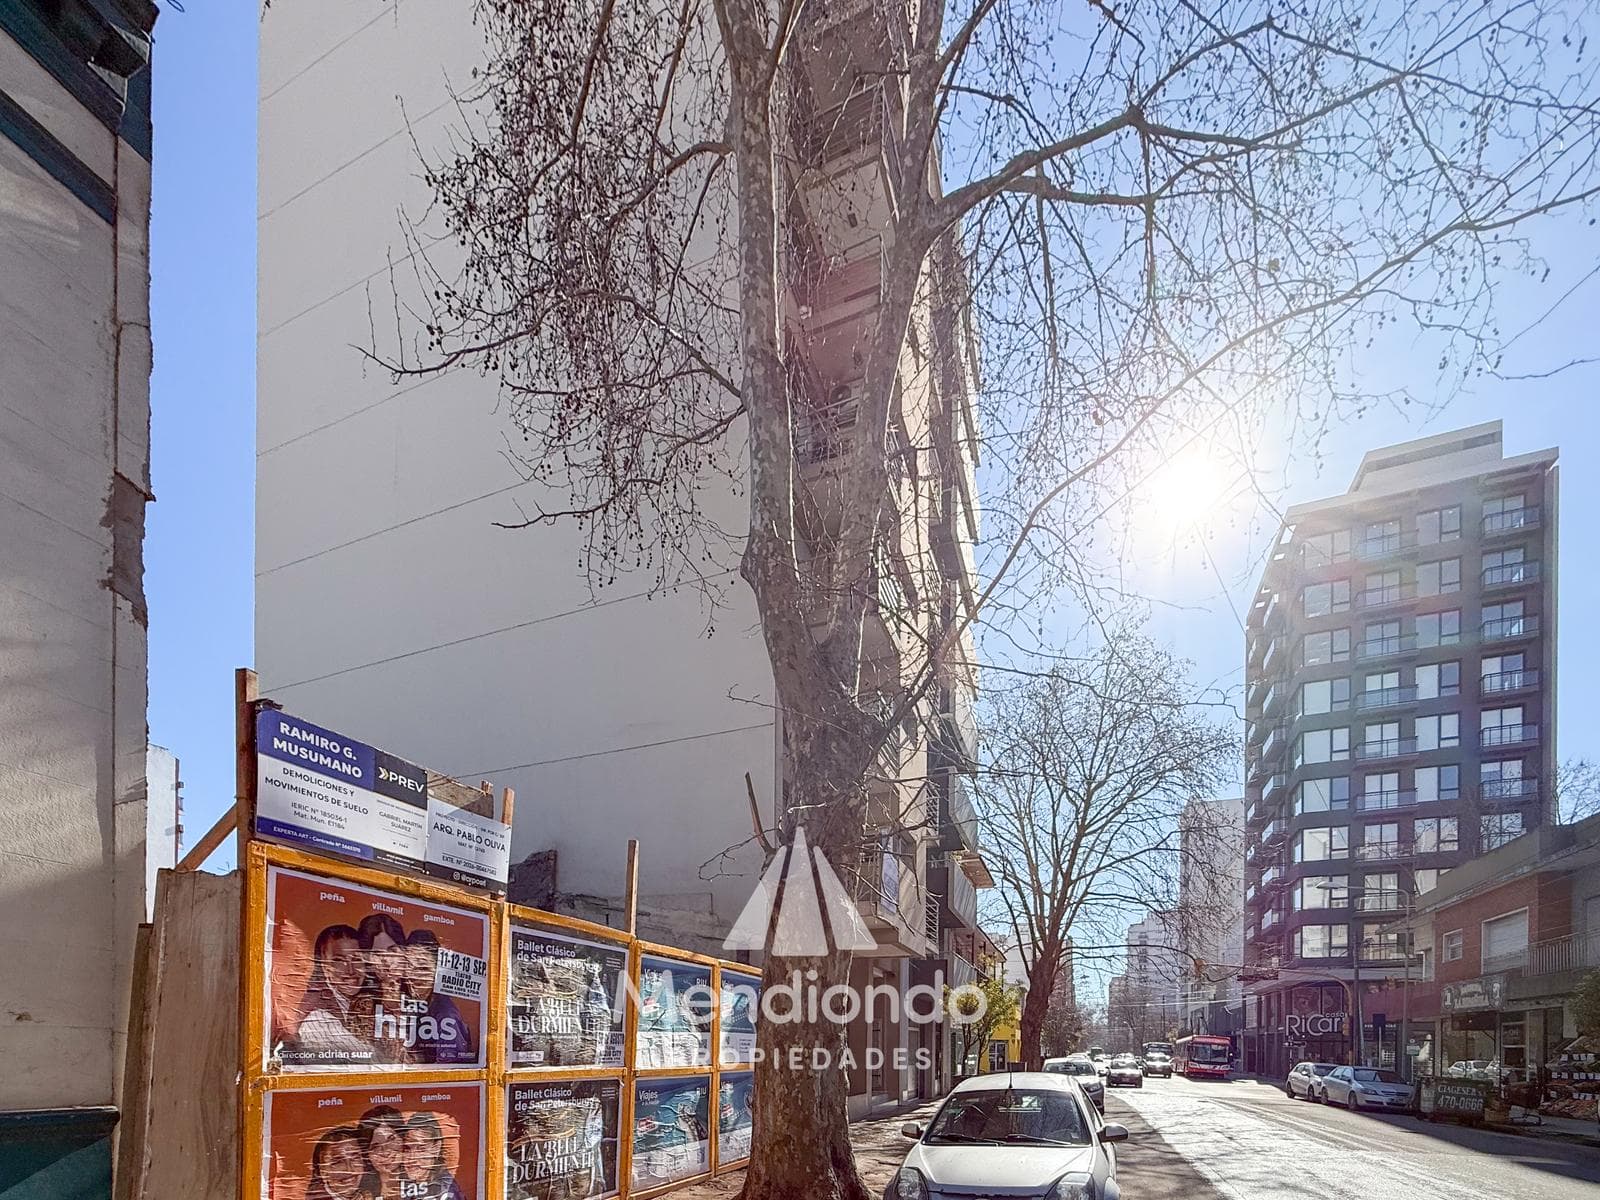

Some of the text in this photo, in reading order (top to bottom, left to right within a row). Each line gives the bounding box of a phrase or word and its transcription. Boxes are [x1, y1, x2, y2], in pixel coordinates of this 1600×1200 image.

[280, 721, 357, 760] RAMIRO G.
[273, 737, 362, 778] MUSUMANO
[283, 767, 348, 796] DEMOLICIONES
[389, 771, 424, 793] PREV
[265, 776, 329, 803] MOVIMIENTOS
[331, 797, 342, 807] DE
[343, 801, 369, 815] SUELO
[291, 802, 309, 812] IERIC
[456, 828, 483, 844] PABLO
[484, 838, 506, 852] OLIVA
[320, 891, 345, 903] peña
[372, 902, 404, 915] villamil
[423, 914, 455, 926] gamboa
[517, 940, 576, 958] Ballet Clásico
[517, 951, 529, 962] de
[441, 974, 482, 991] RADIO CITY
[374, 1003, 457, 1047] hijas
[351, 1051, 373, 1059] suar
[370, 1094, 402, 1104] villamil
[421, 1093, 451, 1102] gamboa
[514, 1088, 572, 1100] Ballet Clásico
[318, 1097, 343, 1107] peña
[514, 1101, 528, 1111] de
[400, 1180, 428, 1198] las
